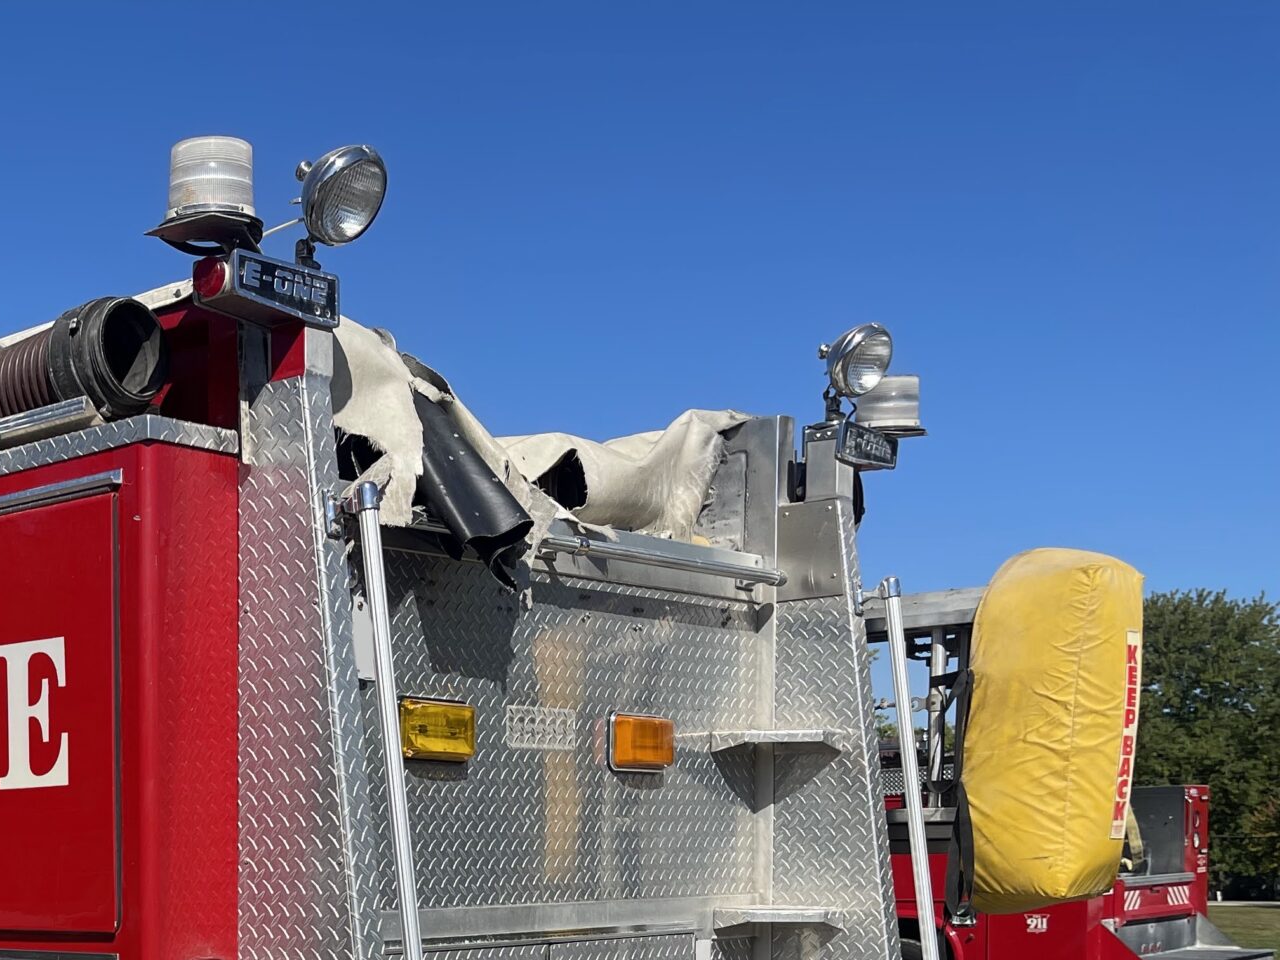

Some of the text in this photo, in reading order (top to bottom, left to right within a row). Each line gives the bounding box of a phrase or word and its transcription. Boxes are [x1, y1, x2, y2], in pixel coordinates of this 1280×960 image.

[242, 259, 329, 305] E-ONE
[1124, 644, 1138, 728] KEEP
[1114, 735, 1133, 820] BACK
[1026, 917, 1048, 929] 911
